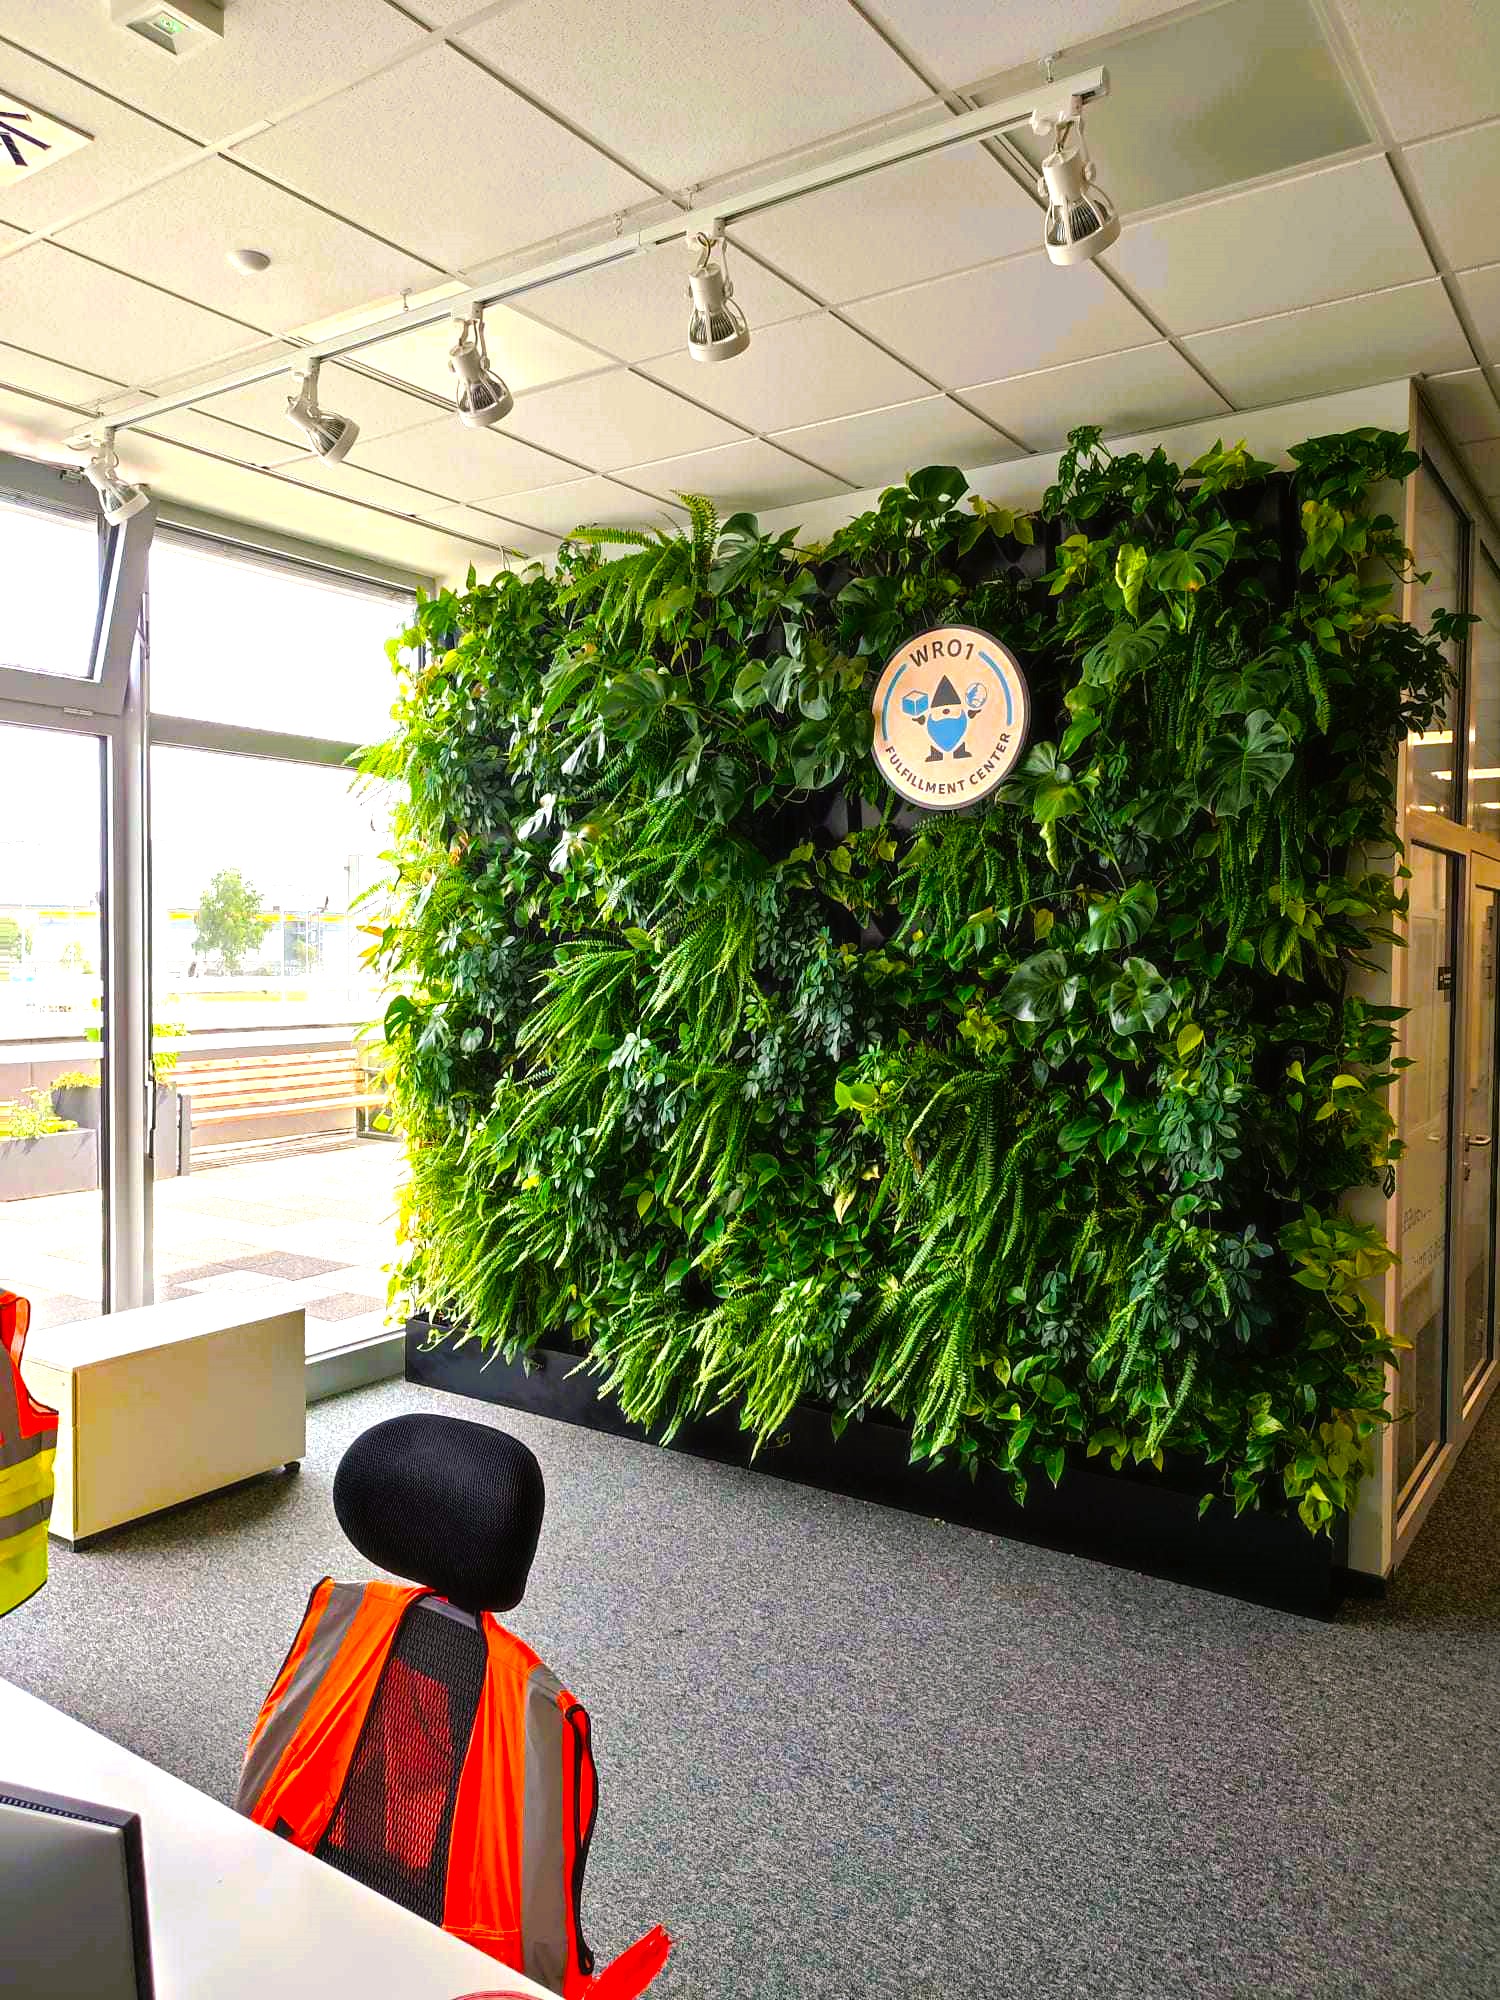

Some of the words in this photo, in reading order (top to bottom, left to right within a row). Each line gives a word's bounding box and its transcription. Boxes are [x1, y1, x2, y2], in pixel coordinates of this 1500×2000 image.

[909, 638, 975, 667] WRO1
[885, 745, 966, 795] FULFILLMENT
[969, 732, 1011, 785] CENTER
